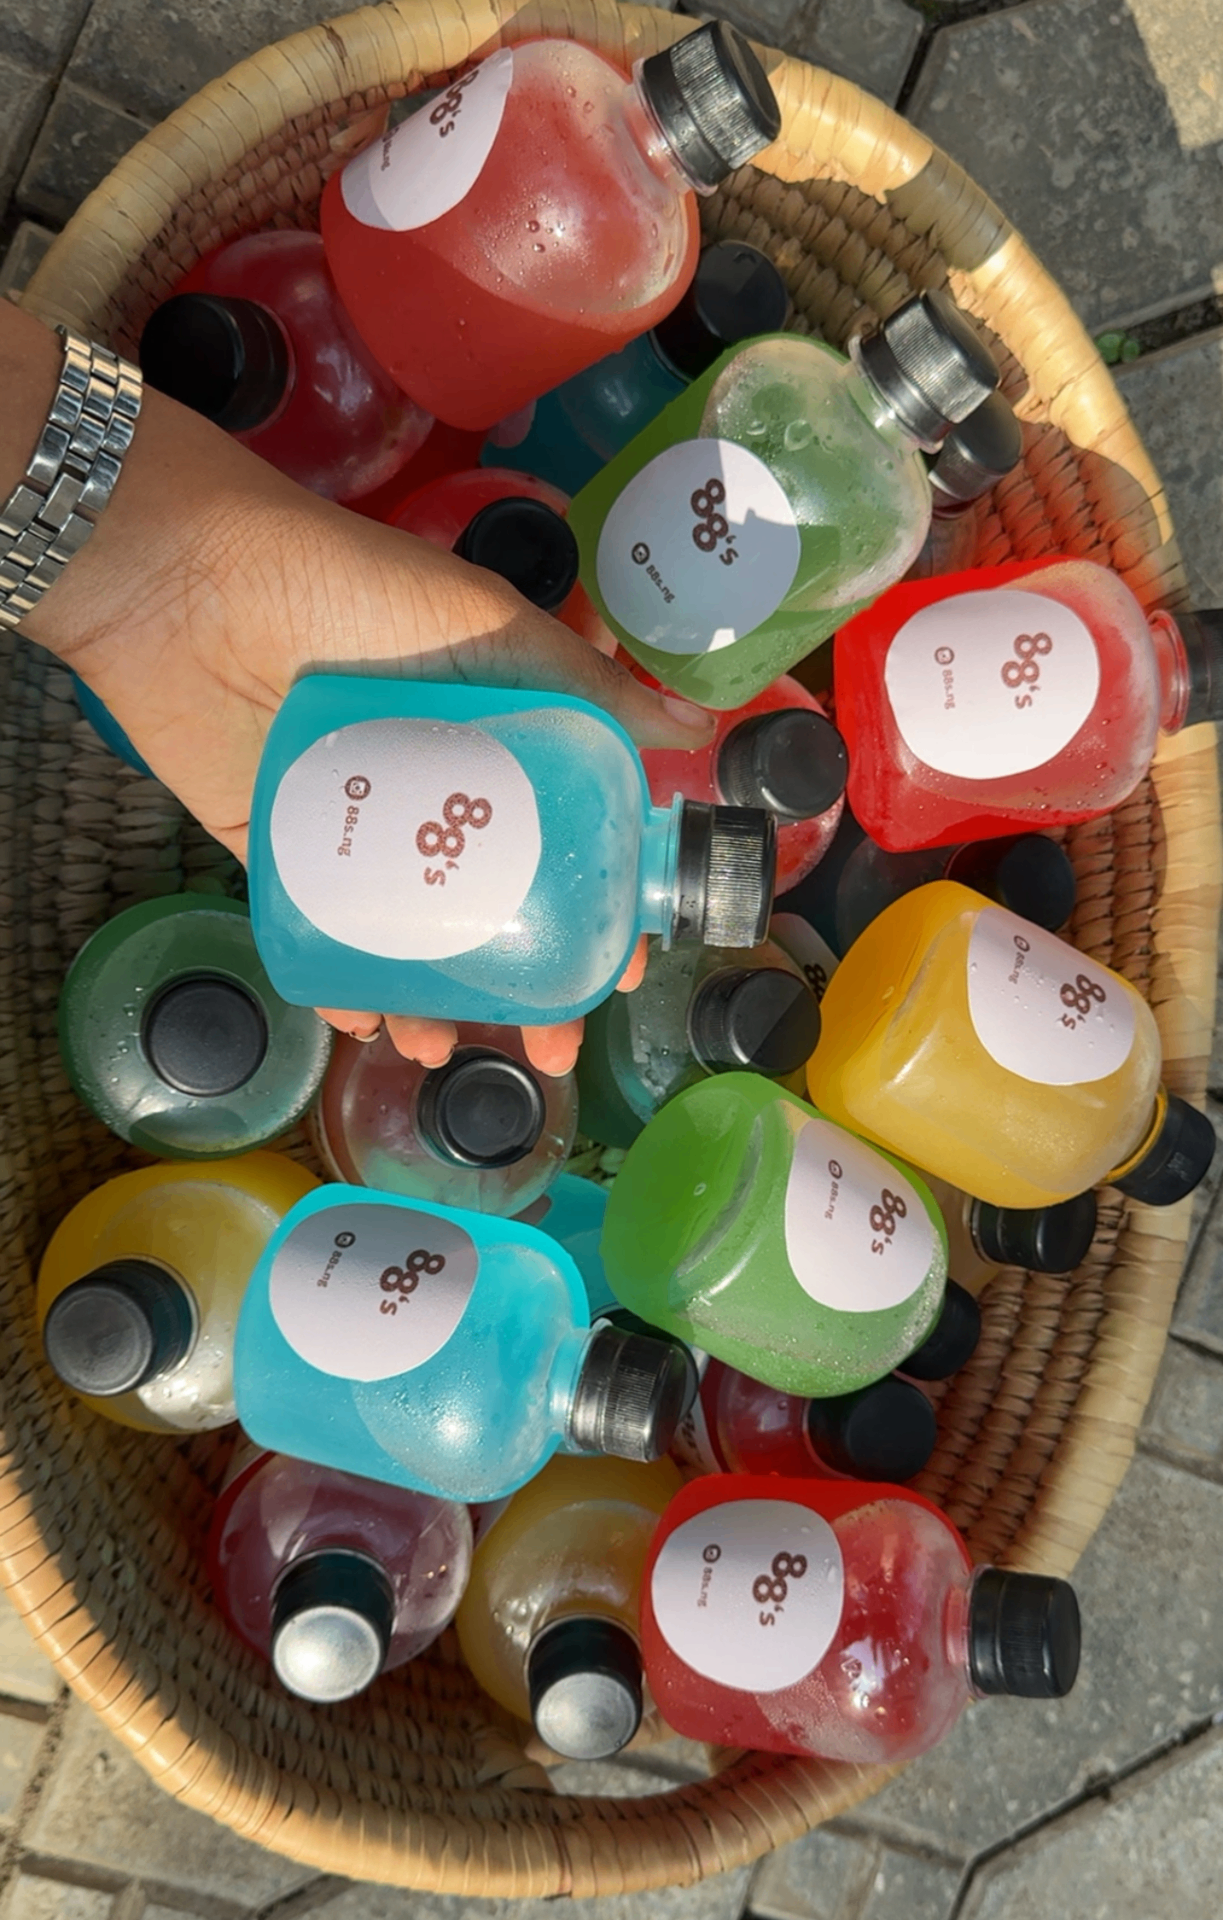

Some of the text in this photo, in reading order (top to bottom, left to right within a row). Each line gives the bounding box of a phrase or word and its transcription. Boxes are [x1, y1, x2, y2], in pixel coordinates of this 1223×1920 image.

[691, 478, 739, 566] 88's
[646, 564, 675, 604] 88s.ng
[942, 669, 955, 710] 88s.ng
[1001, 632, 1053, 709] 88's
[337, 805, 360, 857] 88s.ng
[415, 792, 493, 887] 88's
[1060, 974, 1106, 1030] 88's
[824, 1181, 839, 1220] 88s.ng
[869, 1188, 907, 1256] 88's
[316, 1250, 342, 1288] 88s.ng
[379, 1249, 446, 1316] 88's
[697, 1567, 713, 1607] 88s.ng
[752, 1551, 808, 1627] 88's
